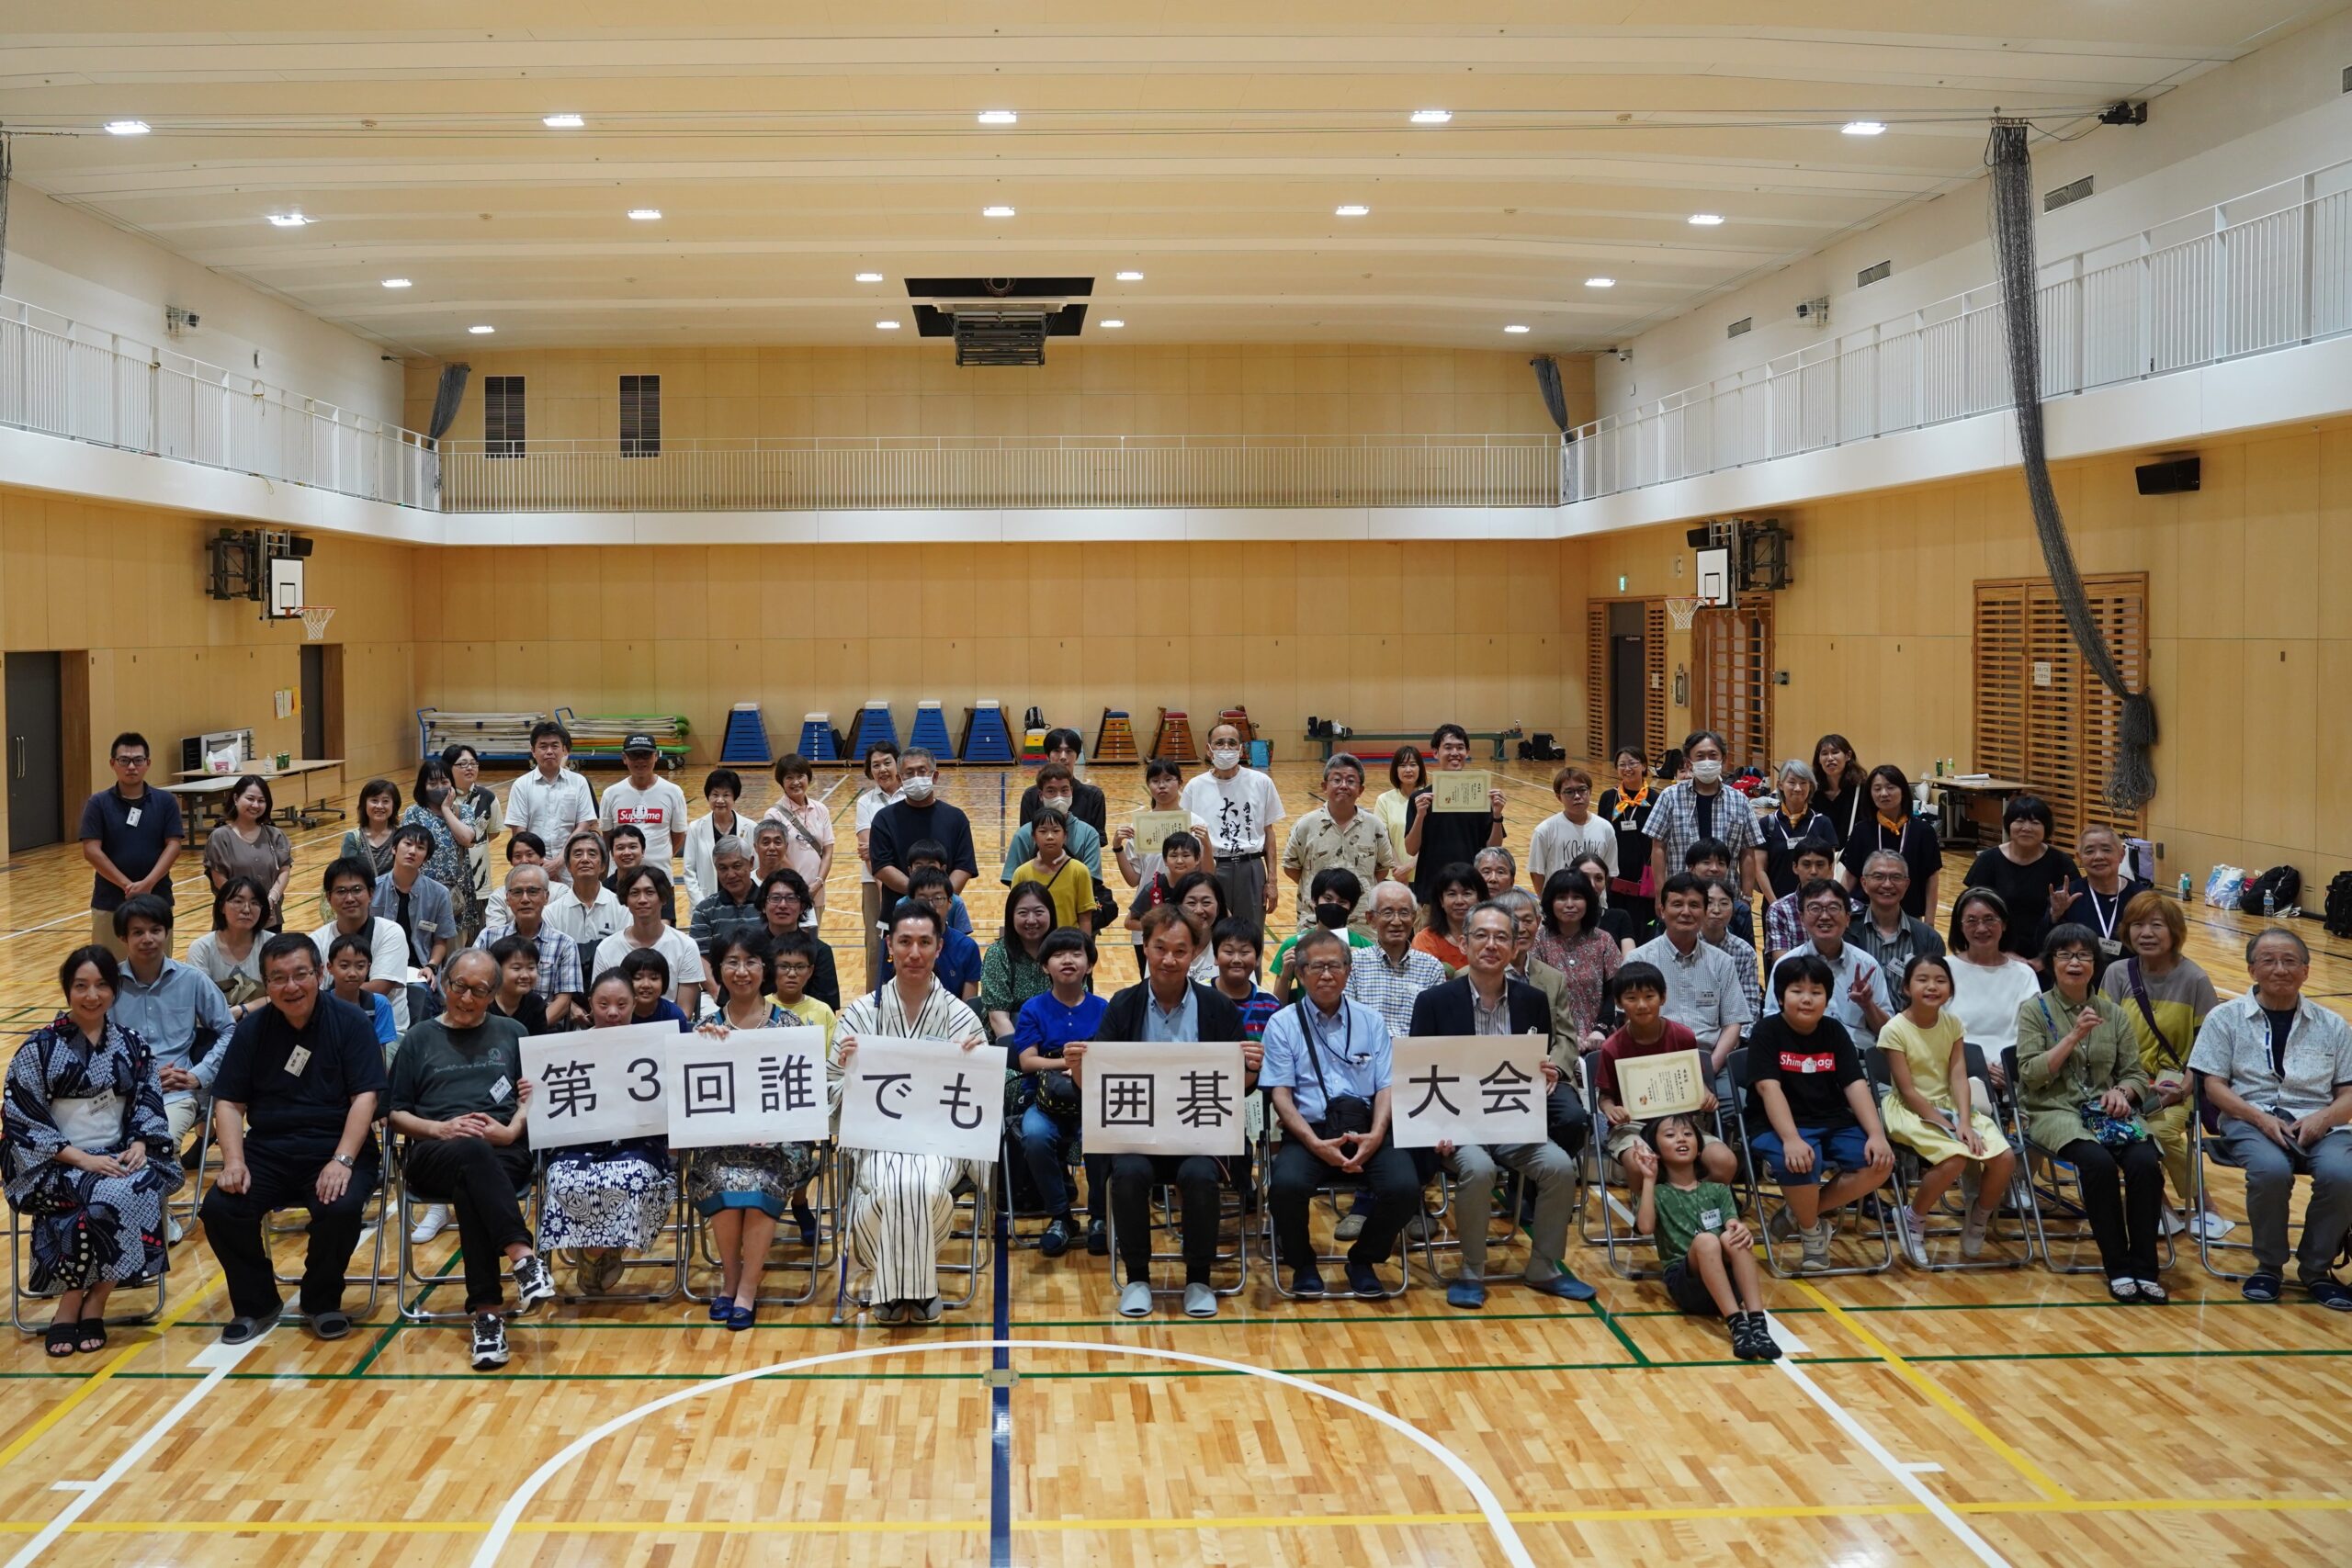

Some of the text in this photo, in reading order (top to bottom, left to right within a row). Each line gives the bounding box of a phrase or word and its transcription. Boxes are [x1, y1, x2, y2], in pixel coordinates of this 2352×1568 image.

[619, 810, 661, 822] Supme
[683, 1054, 817, 1118] 回誰
[862, 1072, 983, 1130] でも
[1101, 1070, 1234, 1128] 囲碁
[1408, 1060, 1533, 1119] 大会
